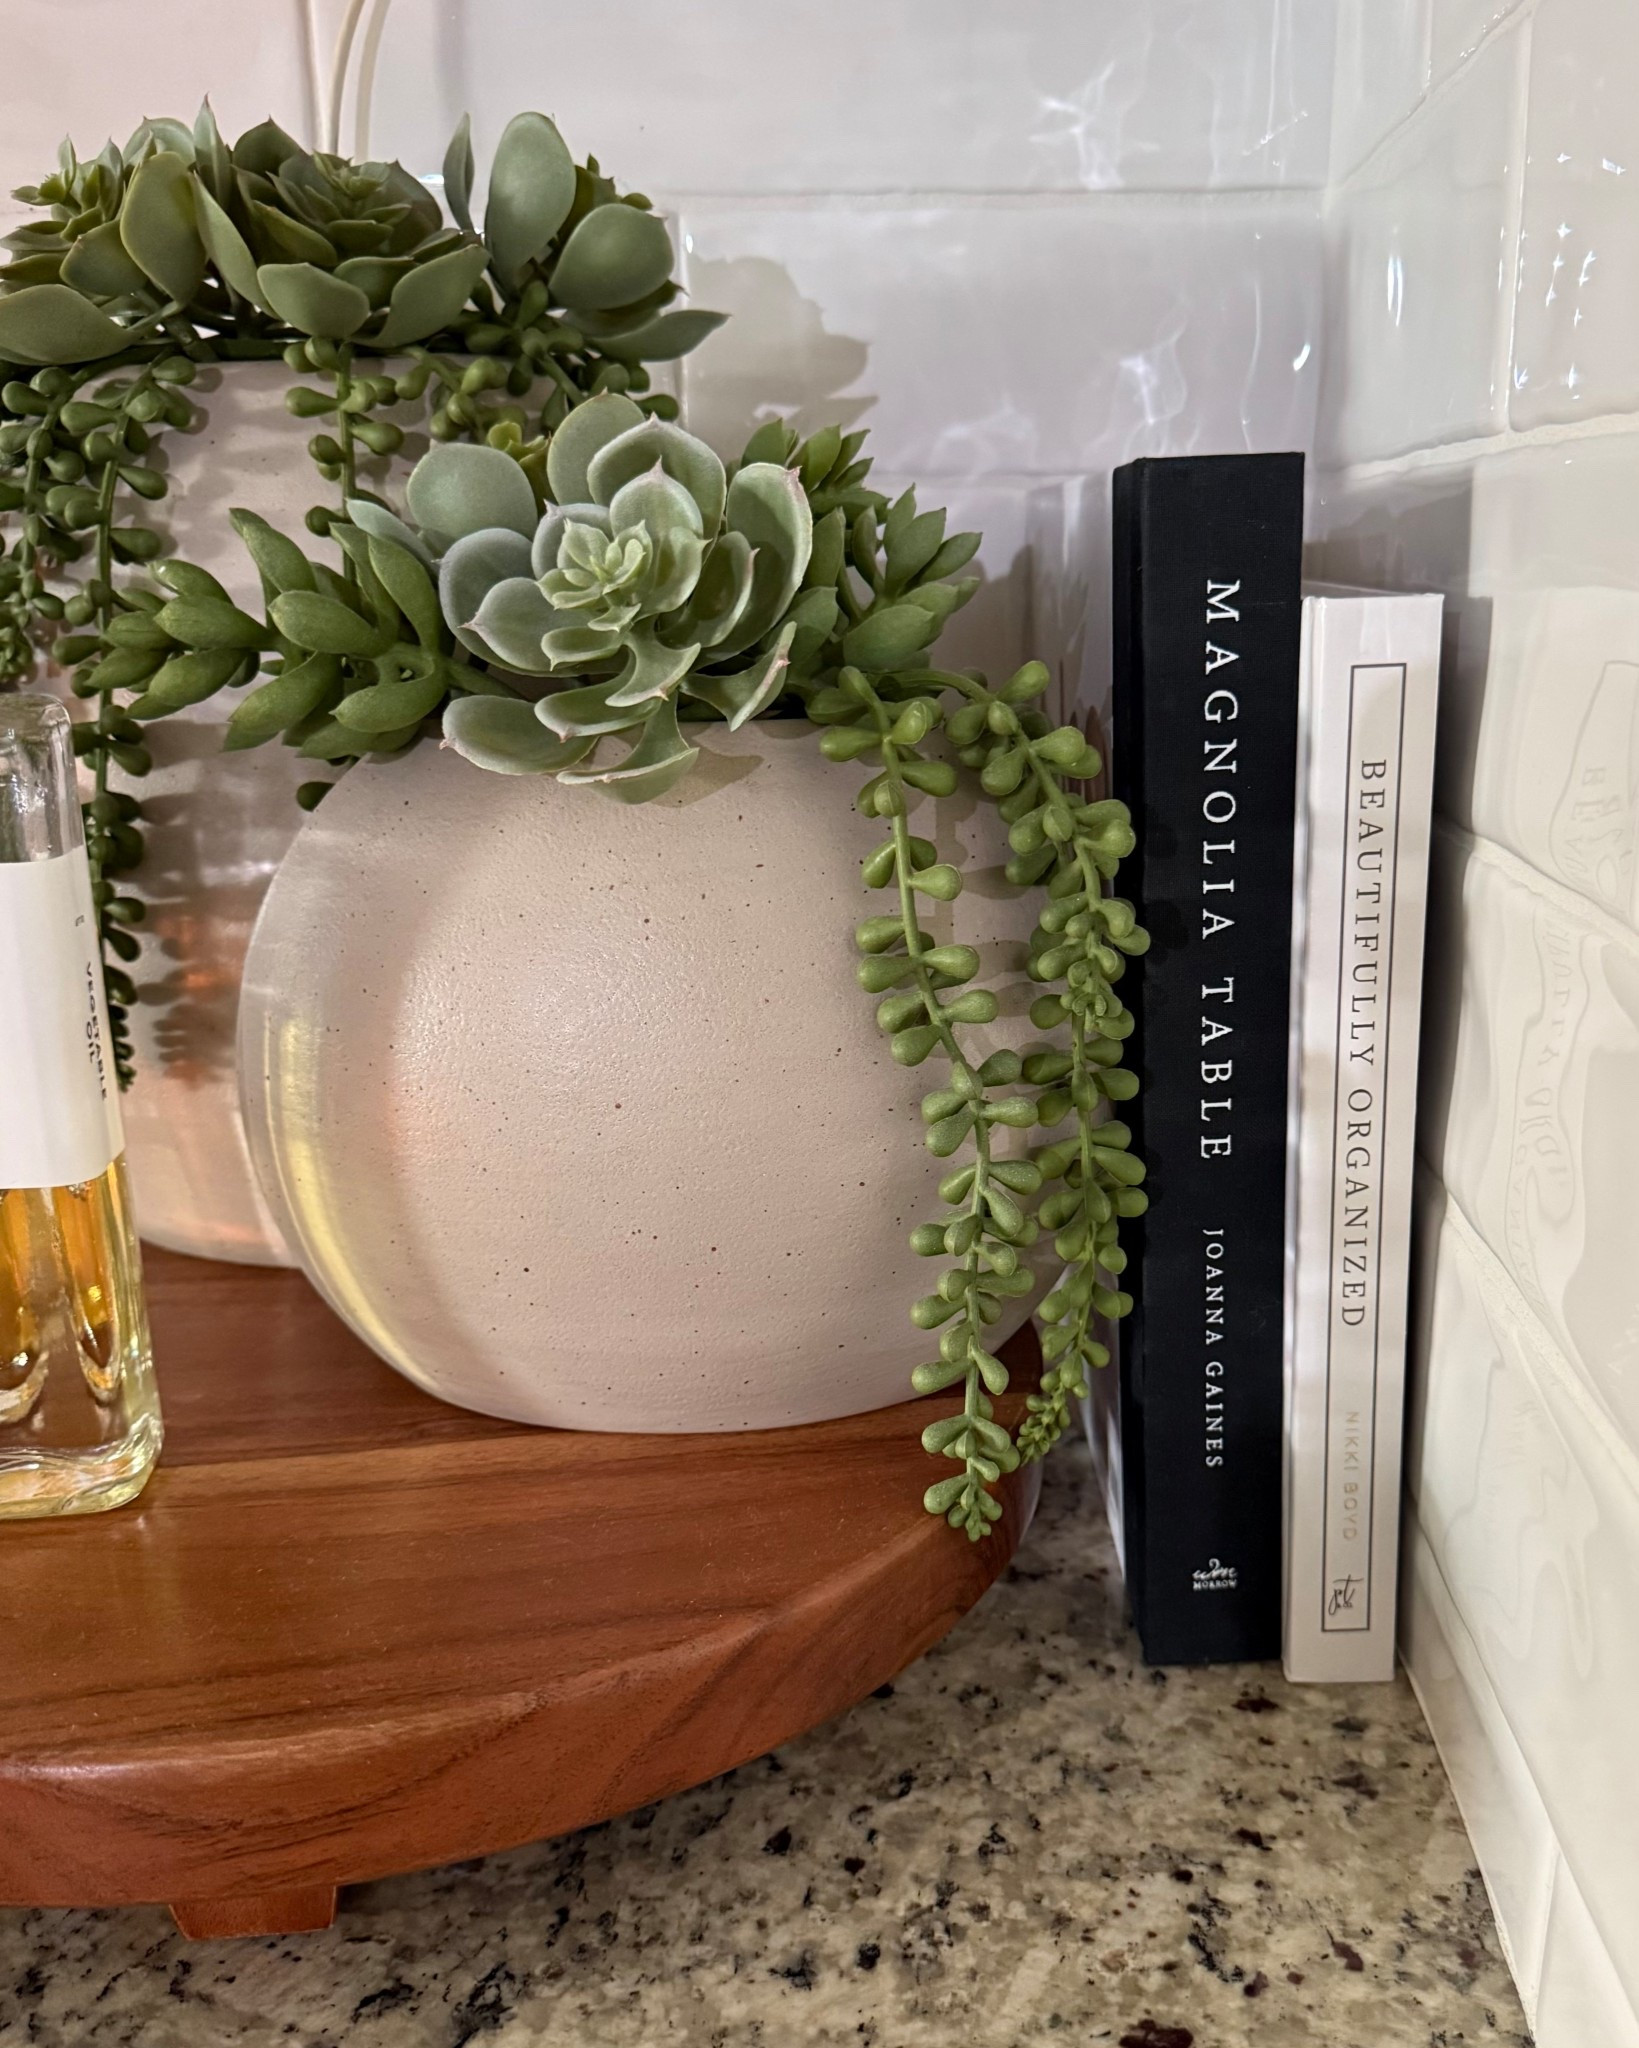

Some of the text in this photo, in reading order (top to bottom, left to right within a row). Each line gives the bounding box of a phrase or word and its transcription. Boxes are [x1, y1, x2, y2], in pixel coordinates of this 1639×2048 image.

[1199, 579, 1241, 1160] MAGNOLIA TABLE
[86, 961, 108, 1102] VEGETABLE
[86, 1021, 96, 1064] OIL
[1341, 758, 1387, 1327] BEAUTIFULLY ORGANIZED
[1202, 1228, 1225, 1469] JOANNA GAINES
[1342, 1410, 1360, 1542] NIKKI BOYD
[1192, 1579, 1238, 1591] MORROW
